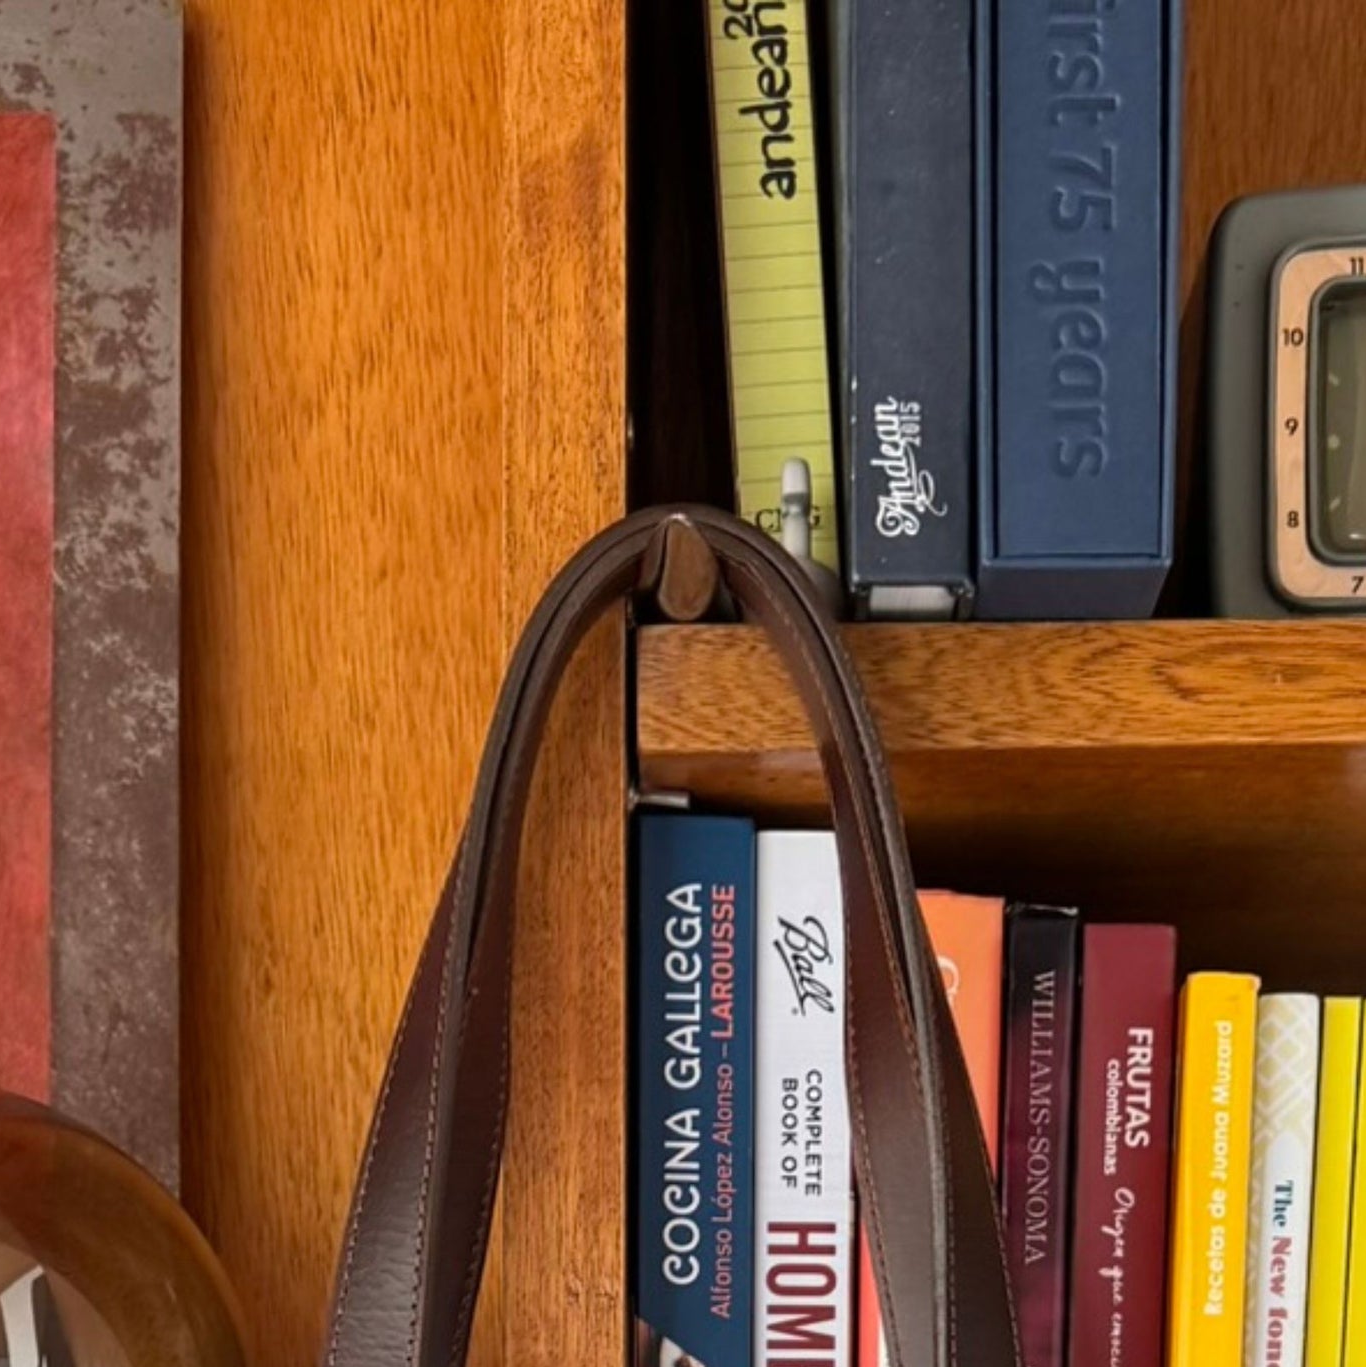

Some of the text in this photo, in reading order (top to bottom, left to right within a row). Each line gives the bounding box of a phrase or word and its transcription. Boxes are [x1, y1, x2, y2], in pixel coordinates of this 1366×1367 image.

[739, 1, 797, 199] andean
[1051, 145, 1118, 231] 75
[1350, 257, 1365, 275] 11
[1032, 257, 1108, 480] years
[1283, 328, 1304, 346] 10
[871, 396, 947, 538] Andean
[1285, 418, 1299, 437] 9
[1287, 511, 1300, 529] 8
[1351, 576, 1364, 594] 7
[663, 883, 702, 1285] COCINA GALLEGA
[710, 884, 737, 1320] Alfonso López Alonso LAROUSSE
[1025, 970, 1055, 1265] WILLIAMS-SONOMA
[1103, 1058, 1120, 1176] colombianas
[1124, 1027, 1153, 1149] FRUTAS
[780, 1078, 798, 1188] BOOK OF
[805, 1069, 822, 1197] COMPLETE
[1210, 1111, 1230, 1182] Juana
[1207, 1188, 1227, 1219] de
[1272, 1180, 1294, 1227] The
[1203, 1226, 1225, 1316] Recetas
[1268, 1236, 1292, 1299] New
